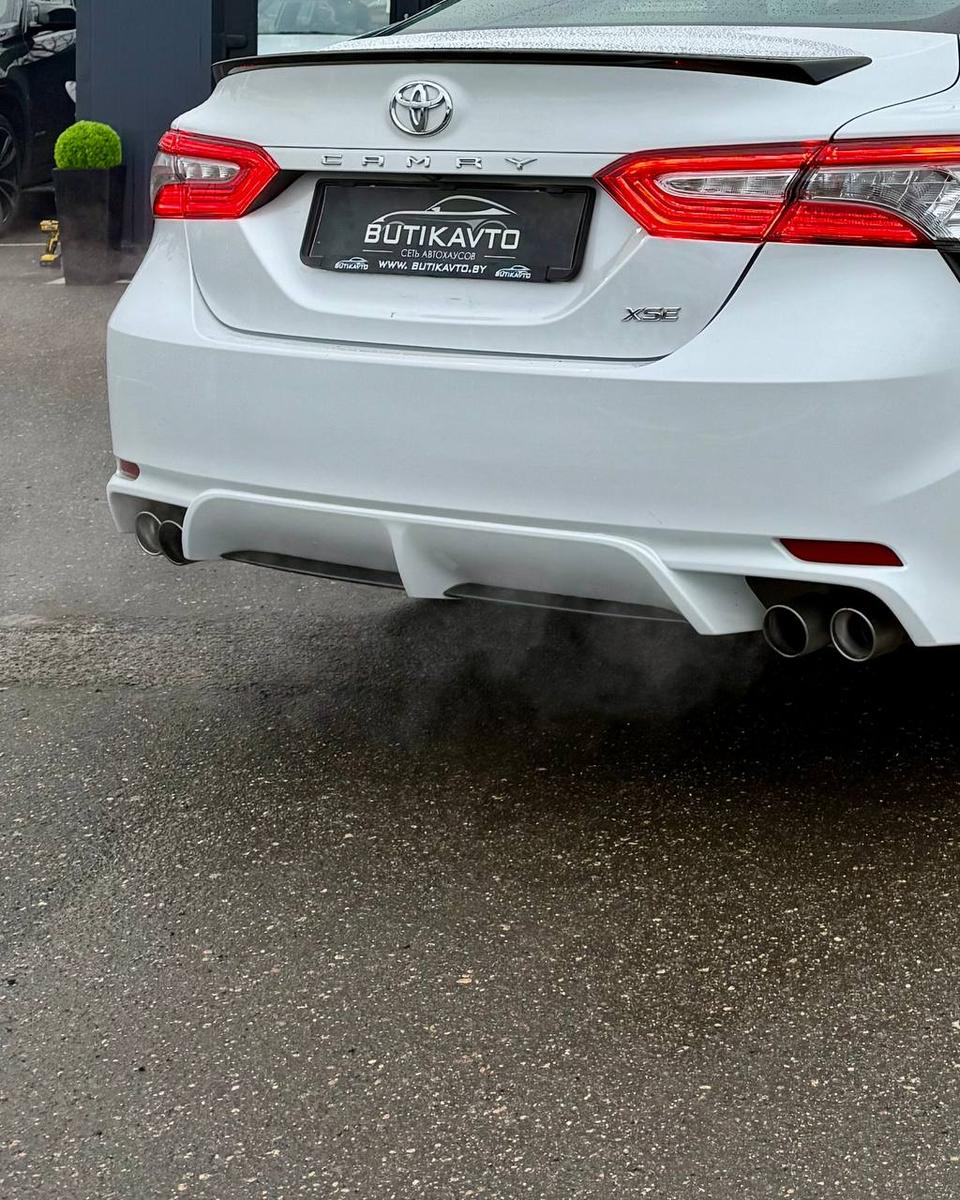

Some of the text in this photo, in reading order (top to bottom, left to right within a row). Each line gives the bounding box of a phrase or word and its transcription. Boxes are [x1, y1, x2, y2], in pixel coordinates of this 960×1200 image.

[320, 154, 539, 171] CAMRY
[364, 223, 521, 250] BUTIKAVTO
[400, 249, 476, 261] СЕТЬ АВТОХАУСОВ
[378, 260, 488, 274] WWW. BUTIKAVTO.BY
[495, 271, 531, 279] BUTIKAVTO
[621, 306, 682, 322] XSE
